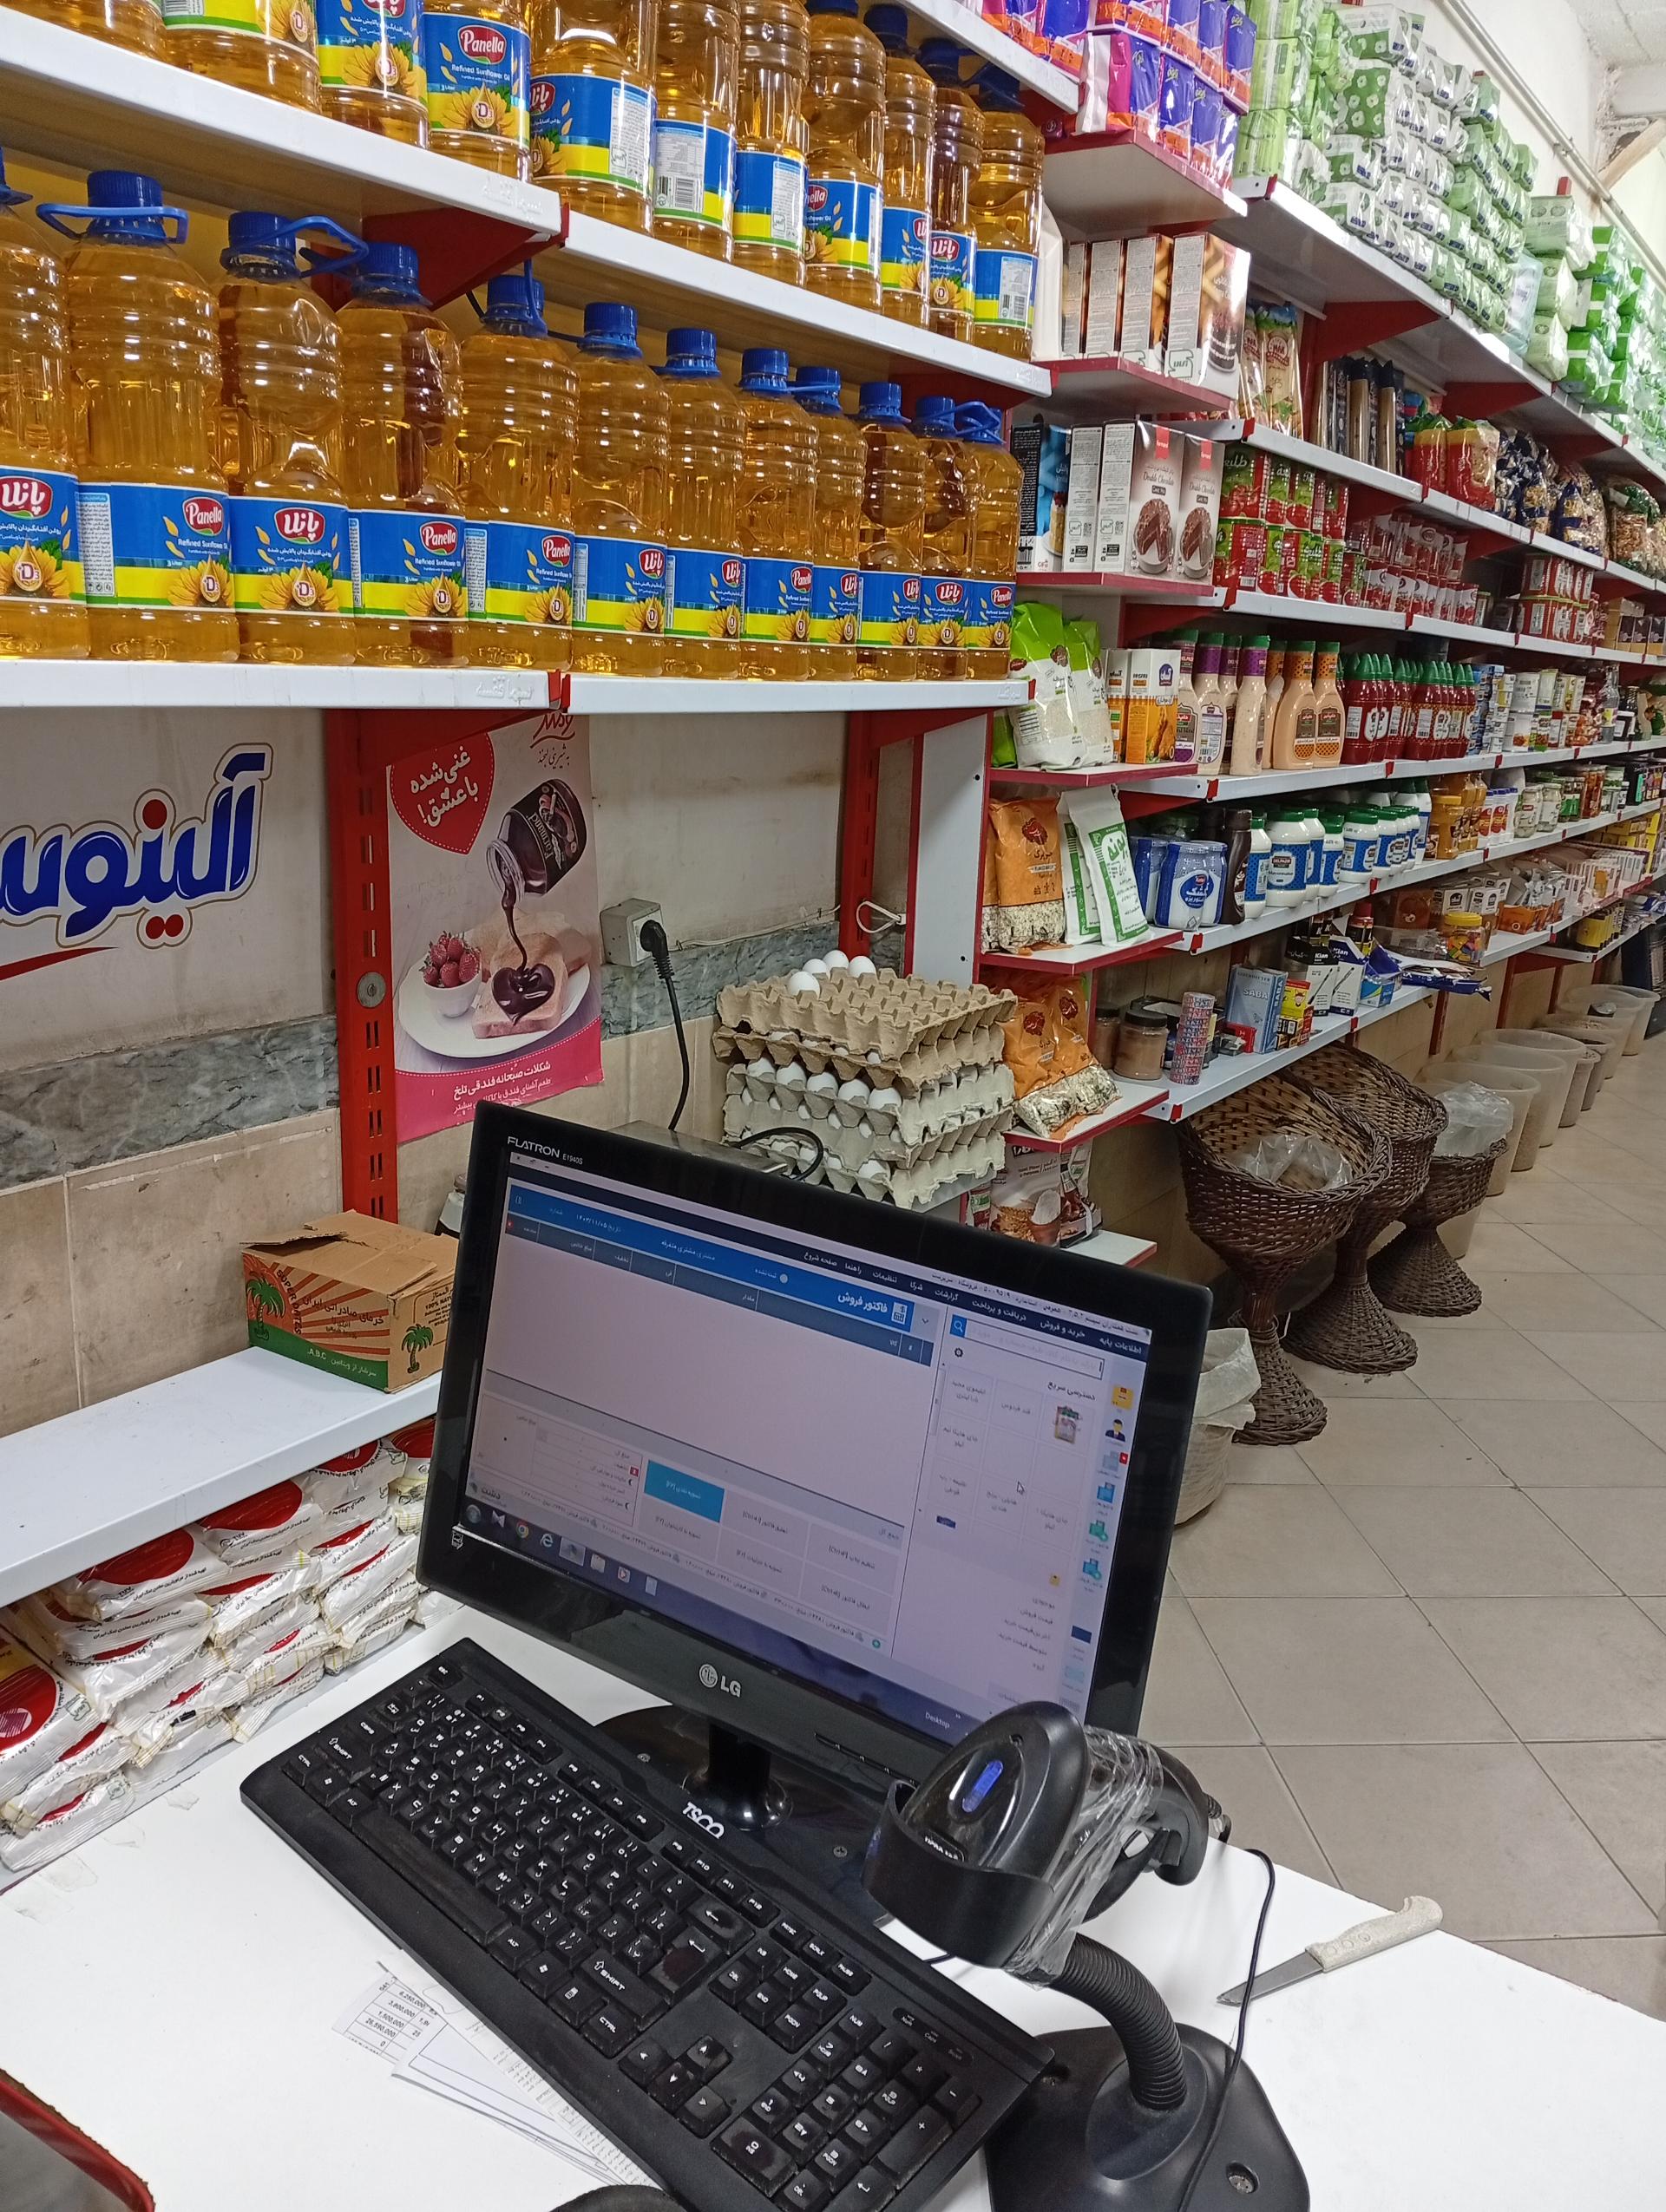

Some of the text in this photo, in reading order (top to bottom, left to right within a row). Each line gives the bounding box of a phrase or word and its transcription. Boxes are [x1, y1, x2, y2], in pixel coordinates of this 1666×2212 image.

[461, 28, 505, 55] Panella
[451, 63, 476, 75] Refined
[476, 67, 503, 79] Sunflower
[932, 238, 956, 260] پانلا
[2, 481, 45, 515] پانلا
[186, 502, 222, 526] Panella
[49, 527, 62, 536] روغن
[284, 513, 320, 541] پانلا
[178, 538, 200, 547] Refined
[422, 527, 457, 546] Panella
[543, 540, 571, 560] Panella
[415, 557, 435, 566] Refined
[645, 553, 663, 577] پانلا
[940, 585, 962, 604] پانلا
[1243, 988, 1269, 999] SABA
[1274, 980, 1284, 1008] SABA
[453, 1060, 551, 1102] شکلات صبحانه فندقی تلخ
[538, 1077, 552, 1091] طعم
[502, 1086, 521, 1100] فندق
[507, 1135, 584, 1165] FLATRON E1940S
[803, 1250, 838, 1267] صفحه شروع
[844, 1262, 863, 1275] راهنما
[872, 1270, 898, 1284] تنظیمات
[276, 1269, 303, 1336] SUPER DATES
[837, 1291, 889, 1314] فاکتور فروش
[934, 1289, 960, 1302] گزارشات
[324, 1301, 357, 1319] صادراتی
[424, 1301, 440, 1311] 100%
[971, 1299, 997, 1315] پرداخت
[358, 1312, 385, 1326] خرمای
[1003, 1308, 1027, 1322] دریافت
[1040, 1319, 1061, 1333] فروش
[1066, 1325, 1086, 1338] خرید
[1099, 1335, 1143, 1355] اطلاعات پایه
[330, 1357, 351, 1371] ویتامین
[357, 1365, 377, 1378] سرشار
[719, 1674, 742, 1698] LG
[925, 1711, 951, 1730] Desktop
[298, 1754, 312, 1768] CTRL
[333, 1744, 353, 1761] SHIFT
[682, 1801, 725, 1840] TSCO
[696, 1859, 711, 1871] F10
[722, 1878, 735, 1890] F11
[600, 1969, 626, 1992] SHIFT
[598, 2015, 618, 2034] CTRL
